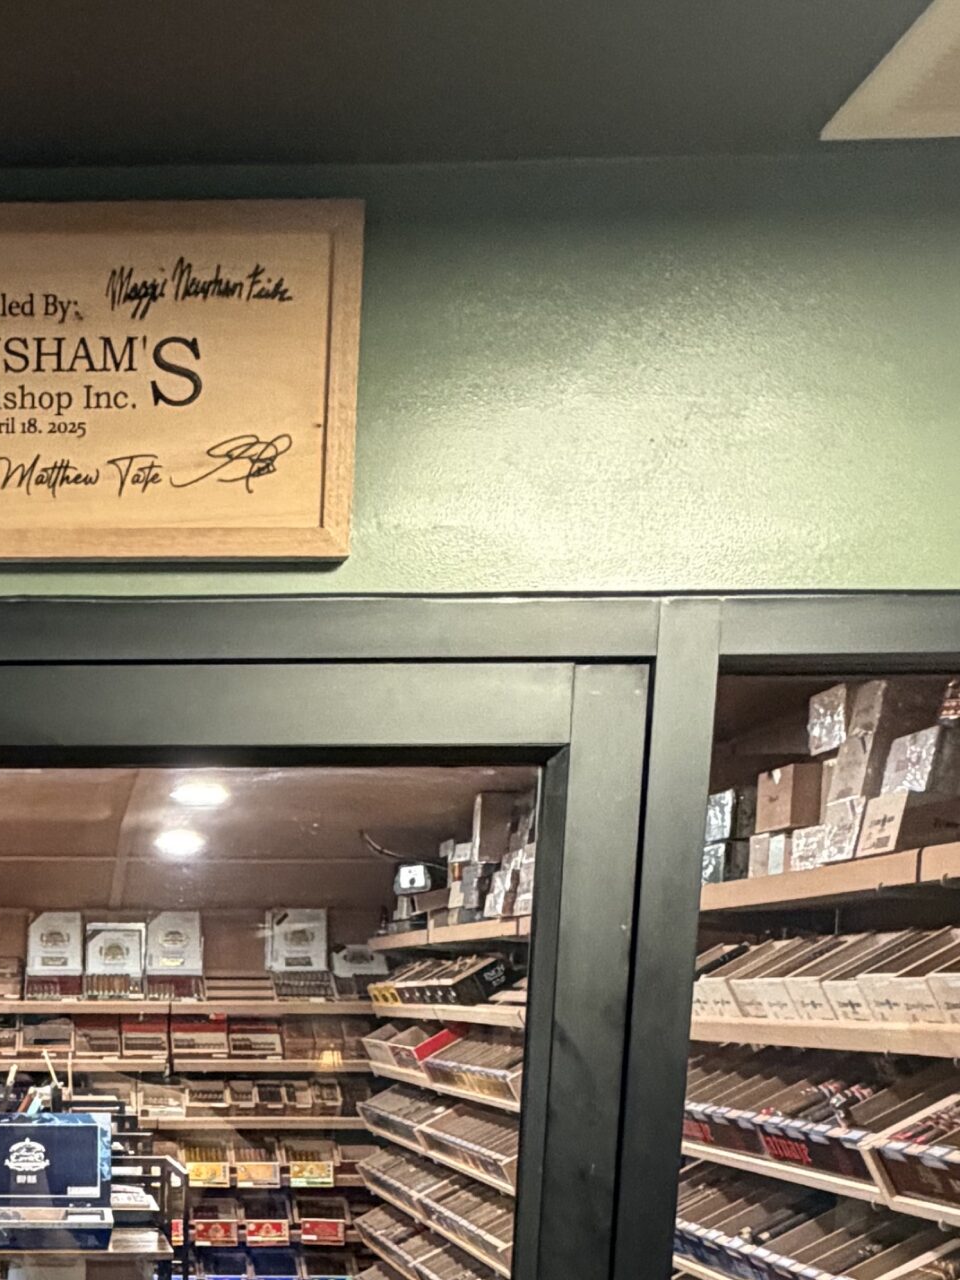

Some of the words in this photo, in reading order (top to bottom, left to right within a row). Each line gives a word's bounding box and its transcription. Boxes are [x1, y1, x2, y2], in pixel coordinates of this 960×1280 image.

[83, 385, 137, 410] Inc.
[47, 421, 87, 439] 2025
[107, 454, 163, 497] Tate
